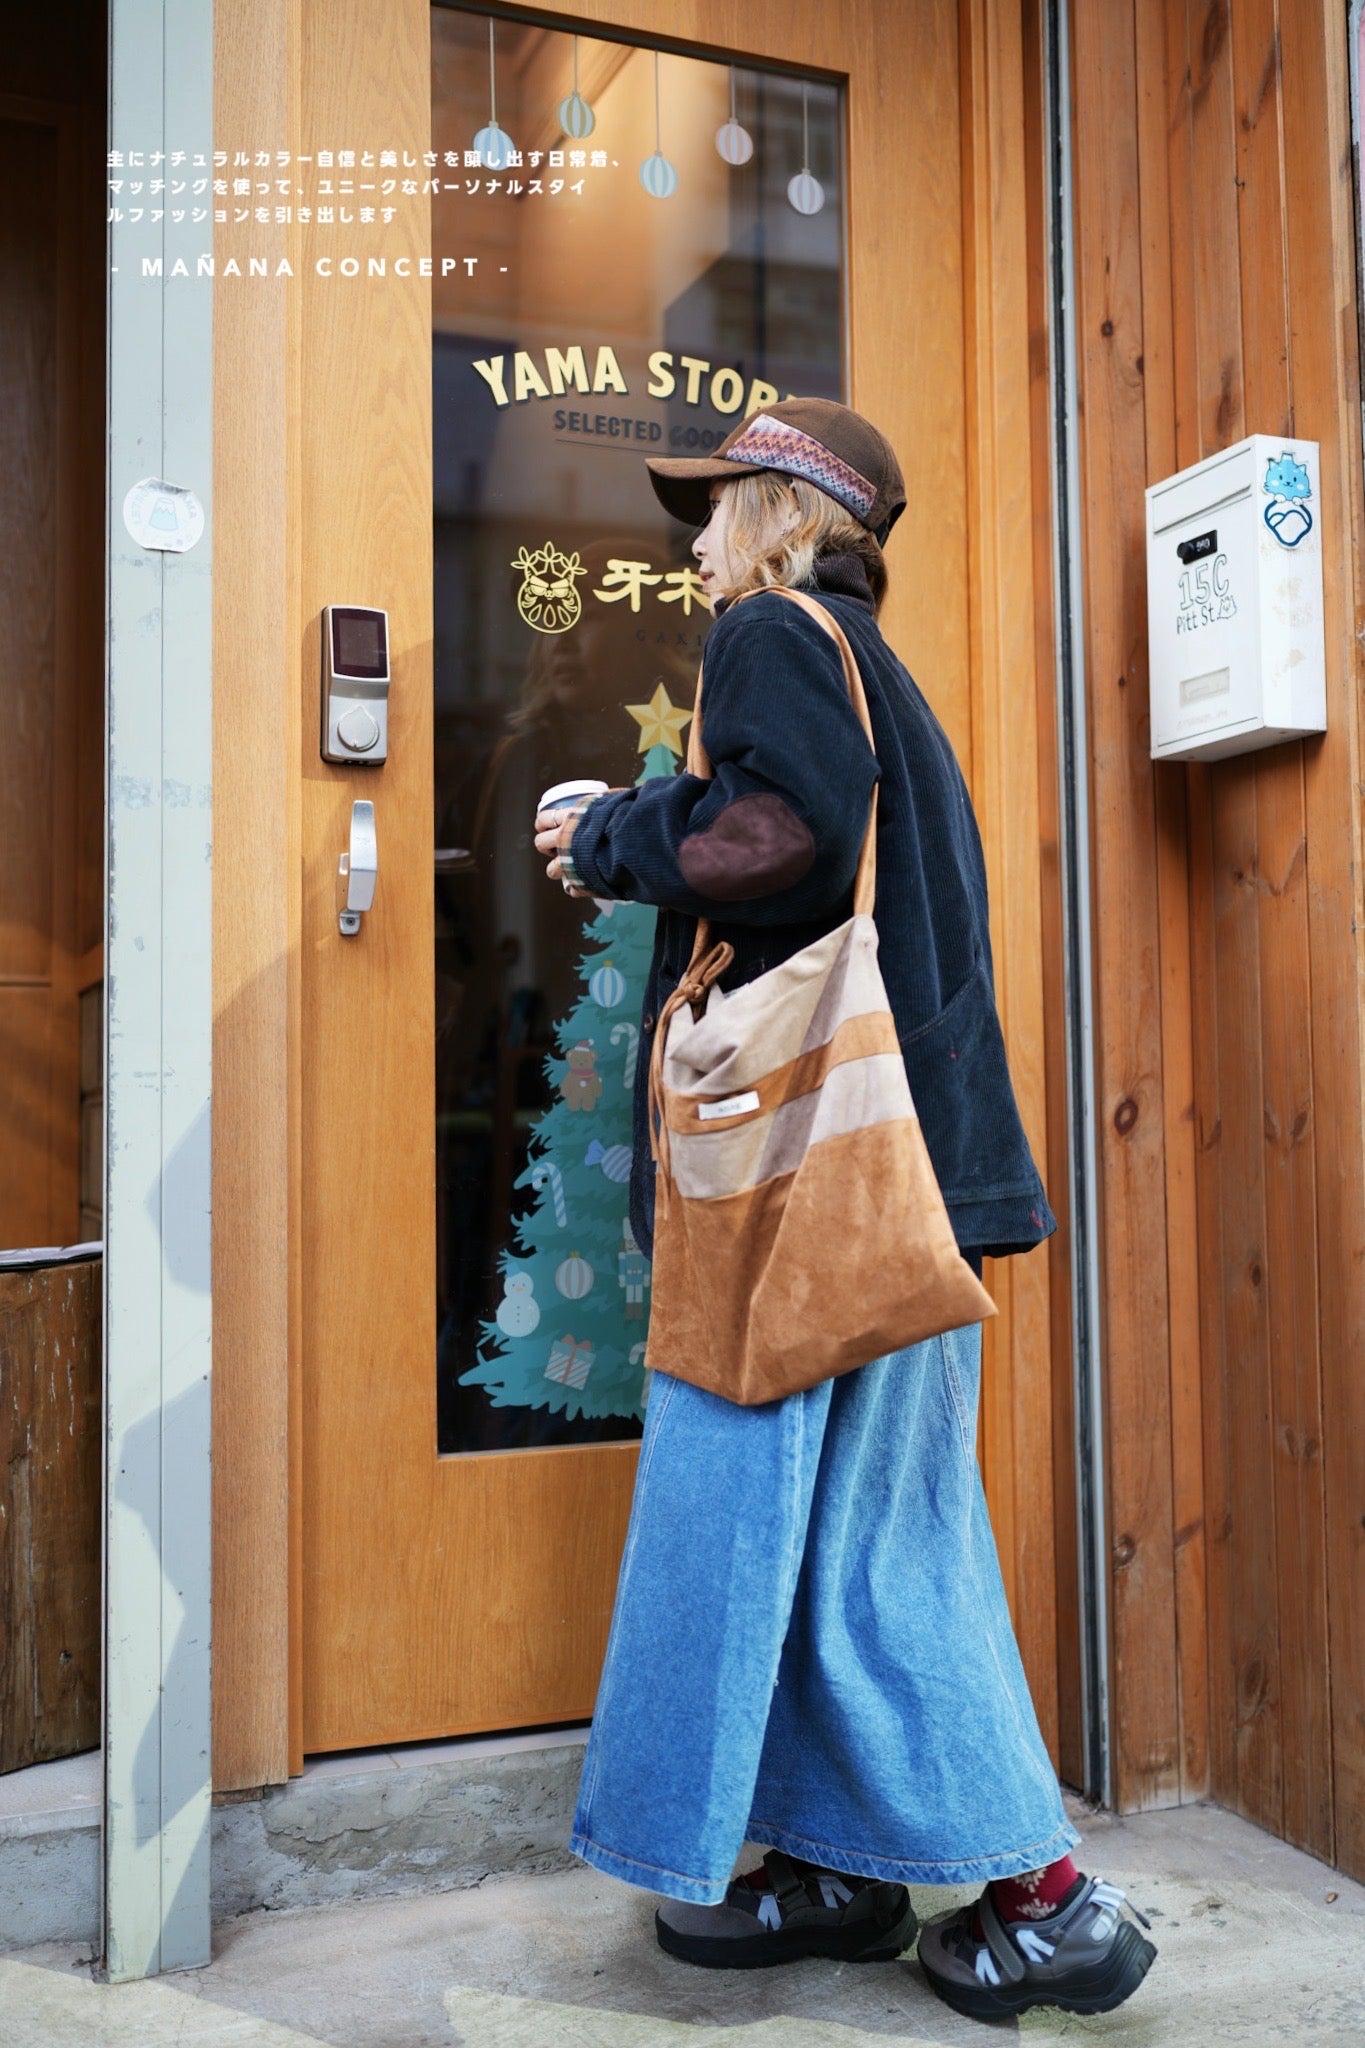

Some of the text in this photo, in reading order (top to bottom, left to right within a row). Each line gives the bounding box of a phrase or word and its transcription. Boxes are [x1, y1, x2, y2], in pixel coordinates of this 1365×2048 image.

[473, 346, 797, 419] YAMA STOR
[554, 409, 662, 442] SELECTED
[1178, 554, 1230, 611] 15C
[1176, 602, 1216, 634] Pitt St
